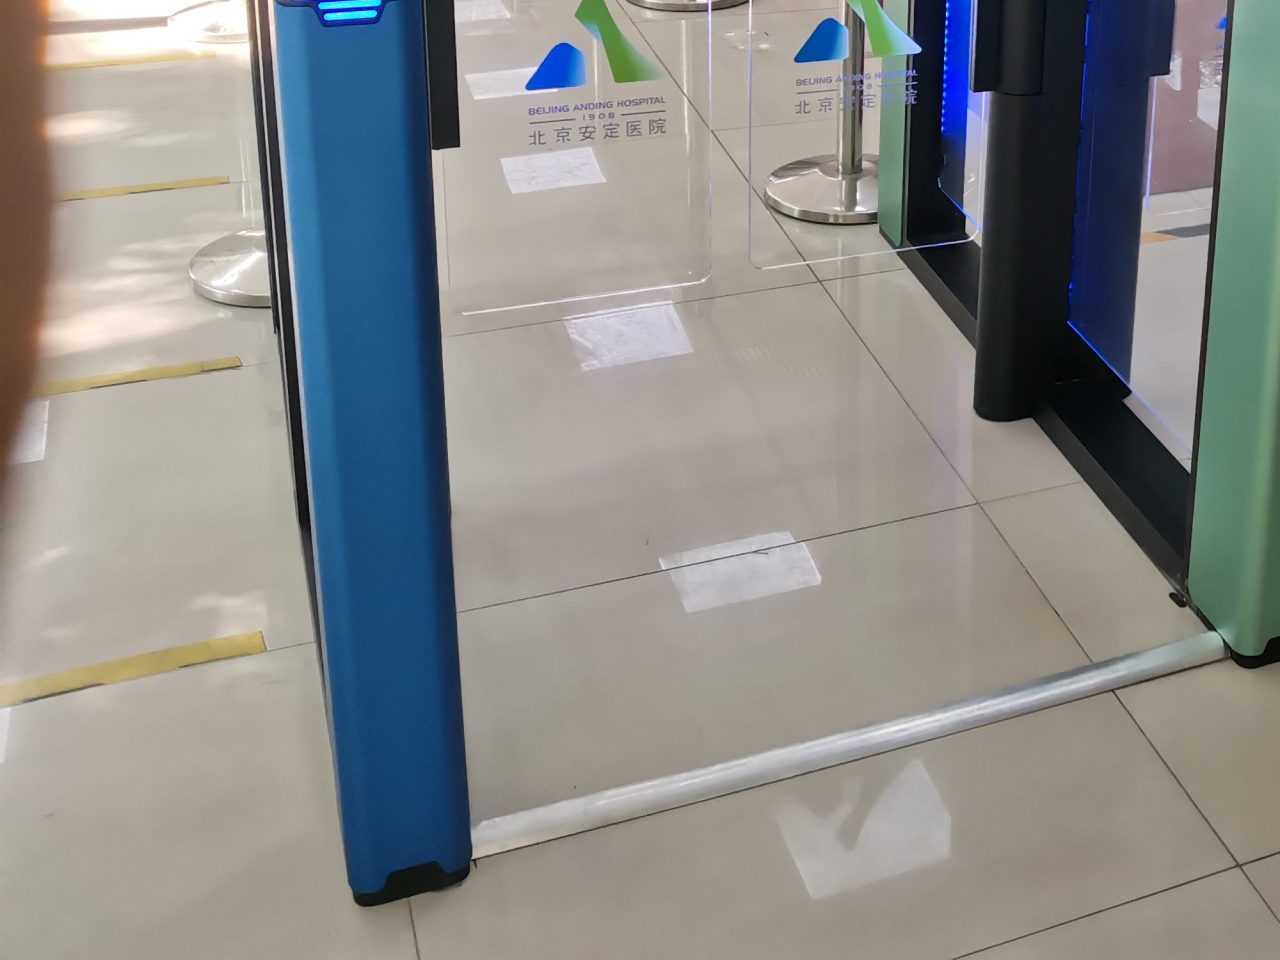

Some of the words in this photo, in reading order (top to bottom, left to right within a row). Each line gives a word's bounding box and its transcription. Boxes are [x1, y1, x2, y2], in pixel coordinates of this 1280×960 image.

[796, 76, 833, 86] BEIJING
[528, 105, 569, 116] BEIJING
[573, 100, 614, 112] ANDING
[617, 96, 666, 108] HOSPITAL
[795, 90, 918, 114] 北京安定院
[583, 111, 615, 121] 1908
[528, 118, 666, 146] 北京安定医院
